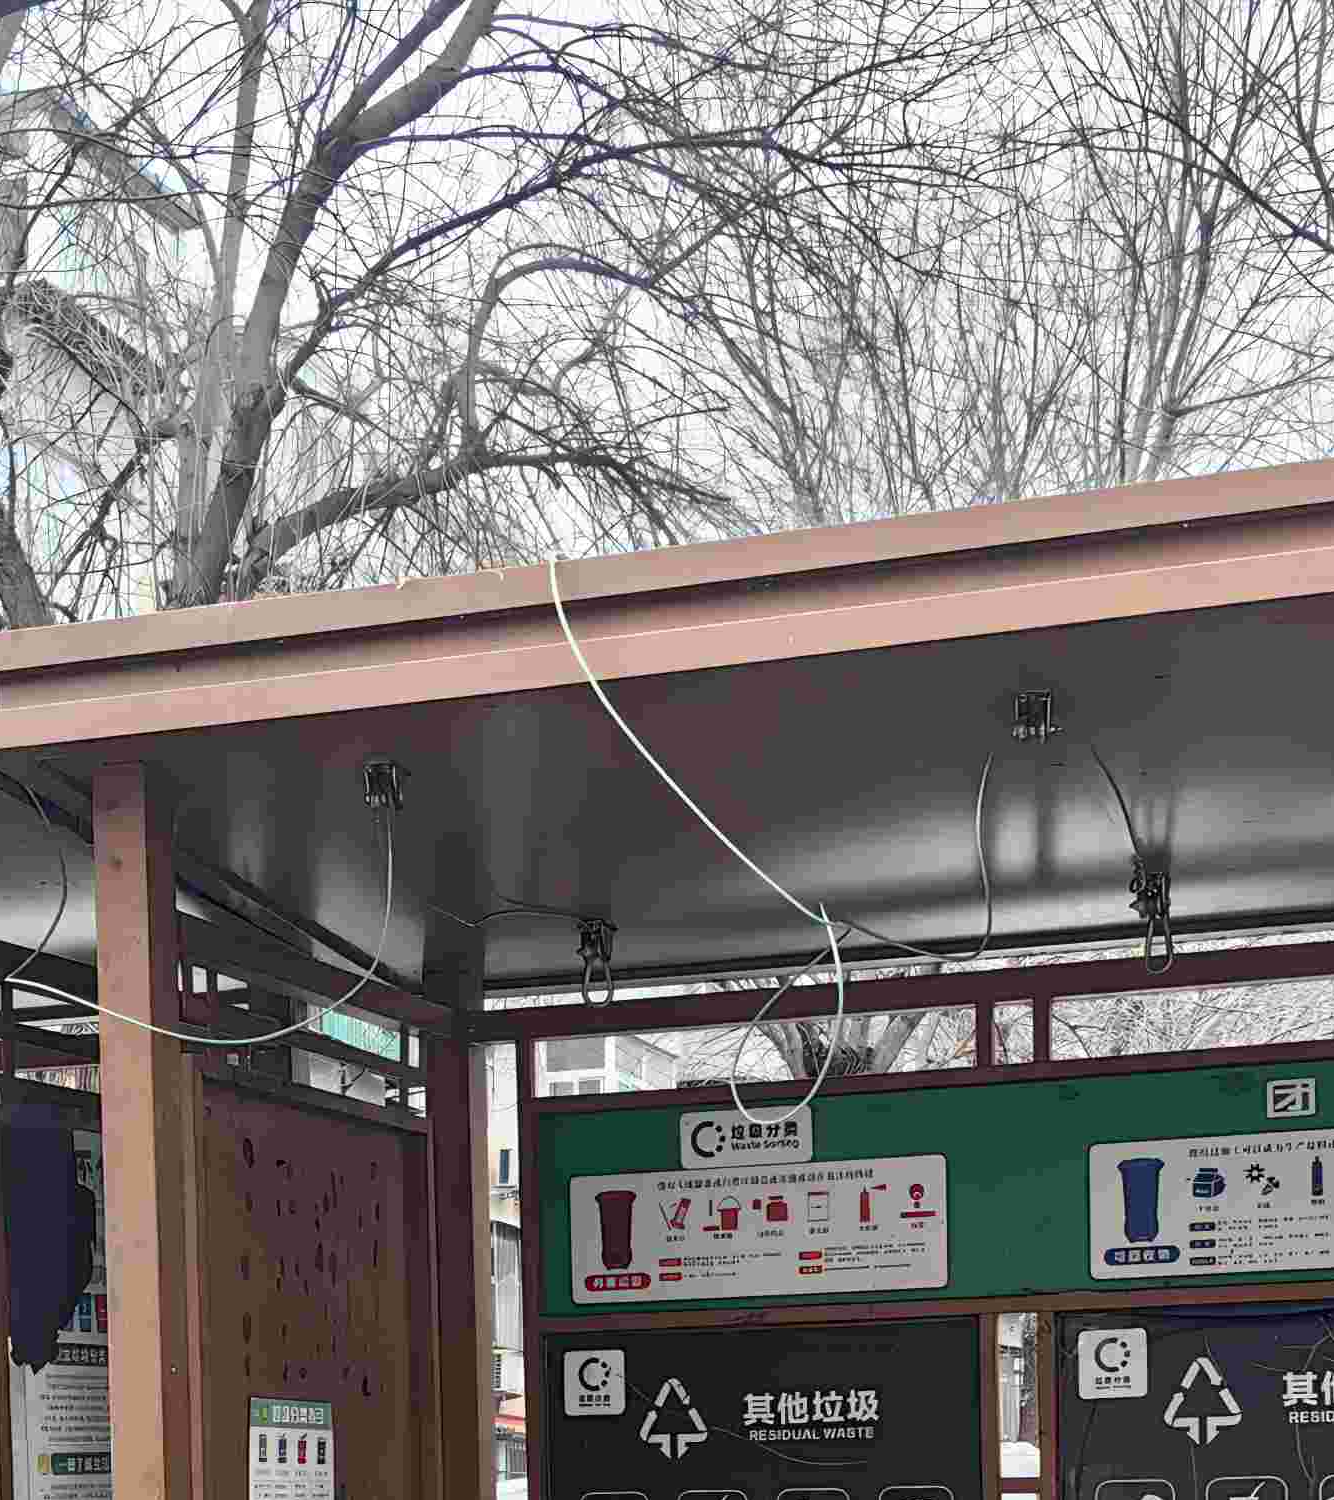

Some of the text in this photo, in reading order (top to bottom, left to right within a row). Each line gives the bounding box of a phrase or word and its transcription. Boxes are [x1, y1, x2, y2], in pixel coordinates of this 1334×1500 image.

[742, 1390, 881, 1426] 其他垃圾
[749, 1427, 820, 1442] RESIDUAL
